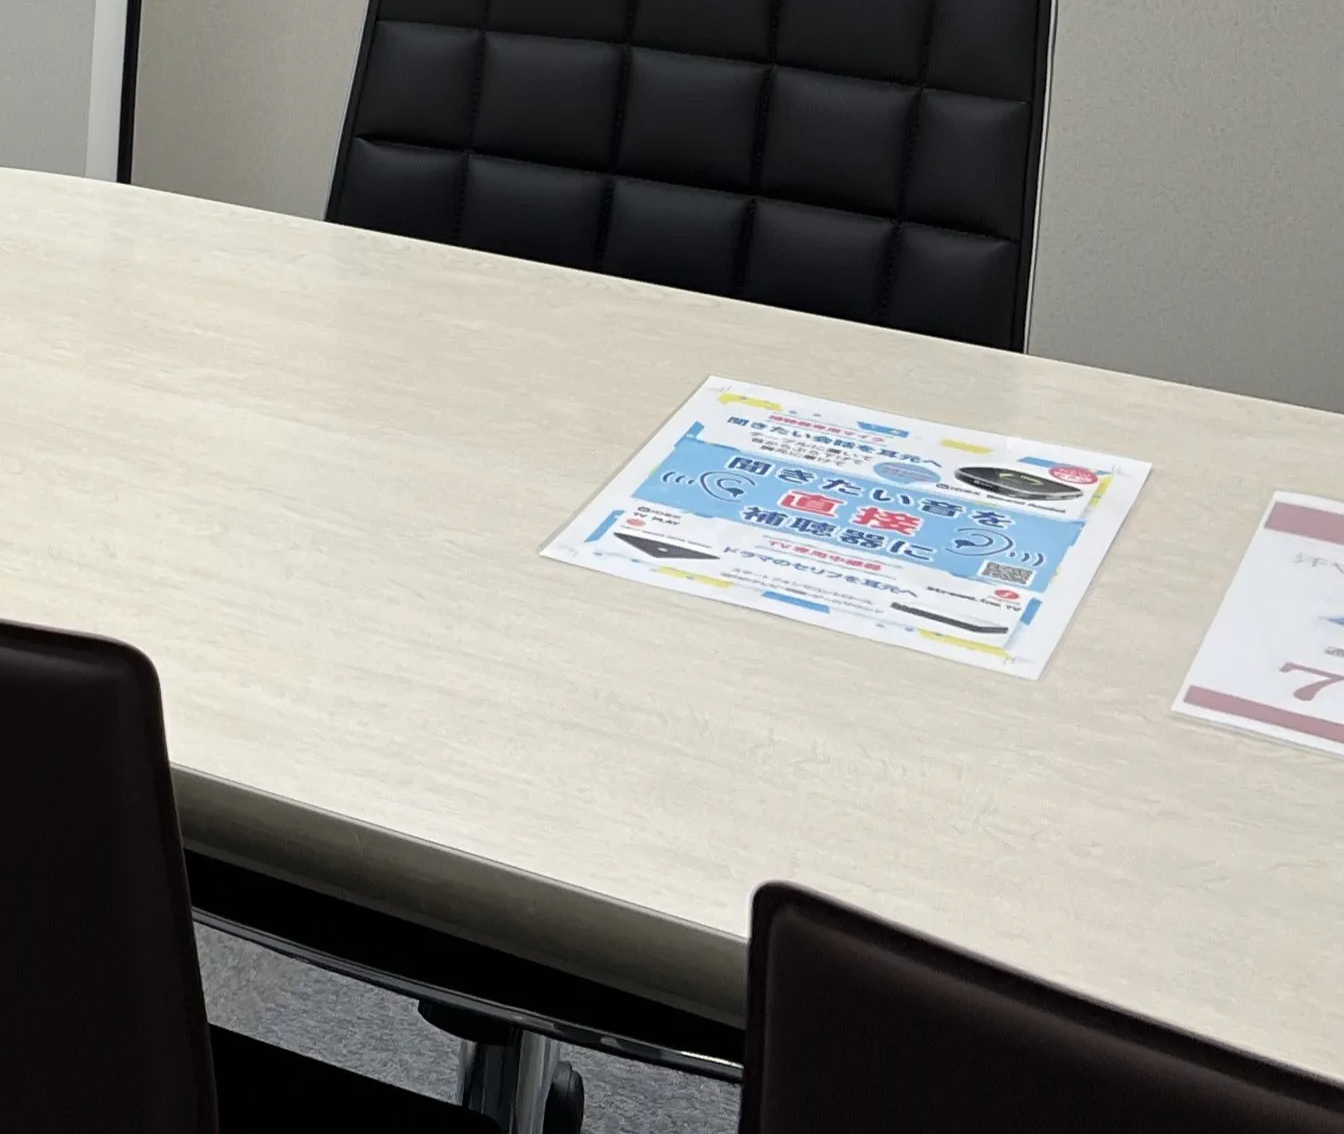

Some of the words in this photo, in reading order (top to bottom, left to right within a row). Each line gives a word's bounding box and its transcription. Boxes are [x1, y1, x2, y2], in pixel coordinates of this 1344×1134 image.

[727, 416, 942, 468] 聞きたい会話を耳元へ
[728, 456, 1014, 527] 聞きたい音を
[780, 490, 922, 535] 直接
[742, 506, 934, 560] 補聴器に
[723, 546, 918, 598] ドラマのセリフを耳元へ
